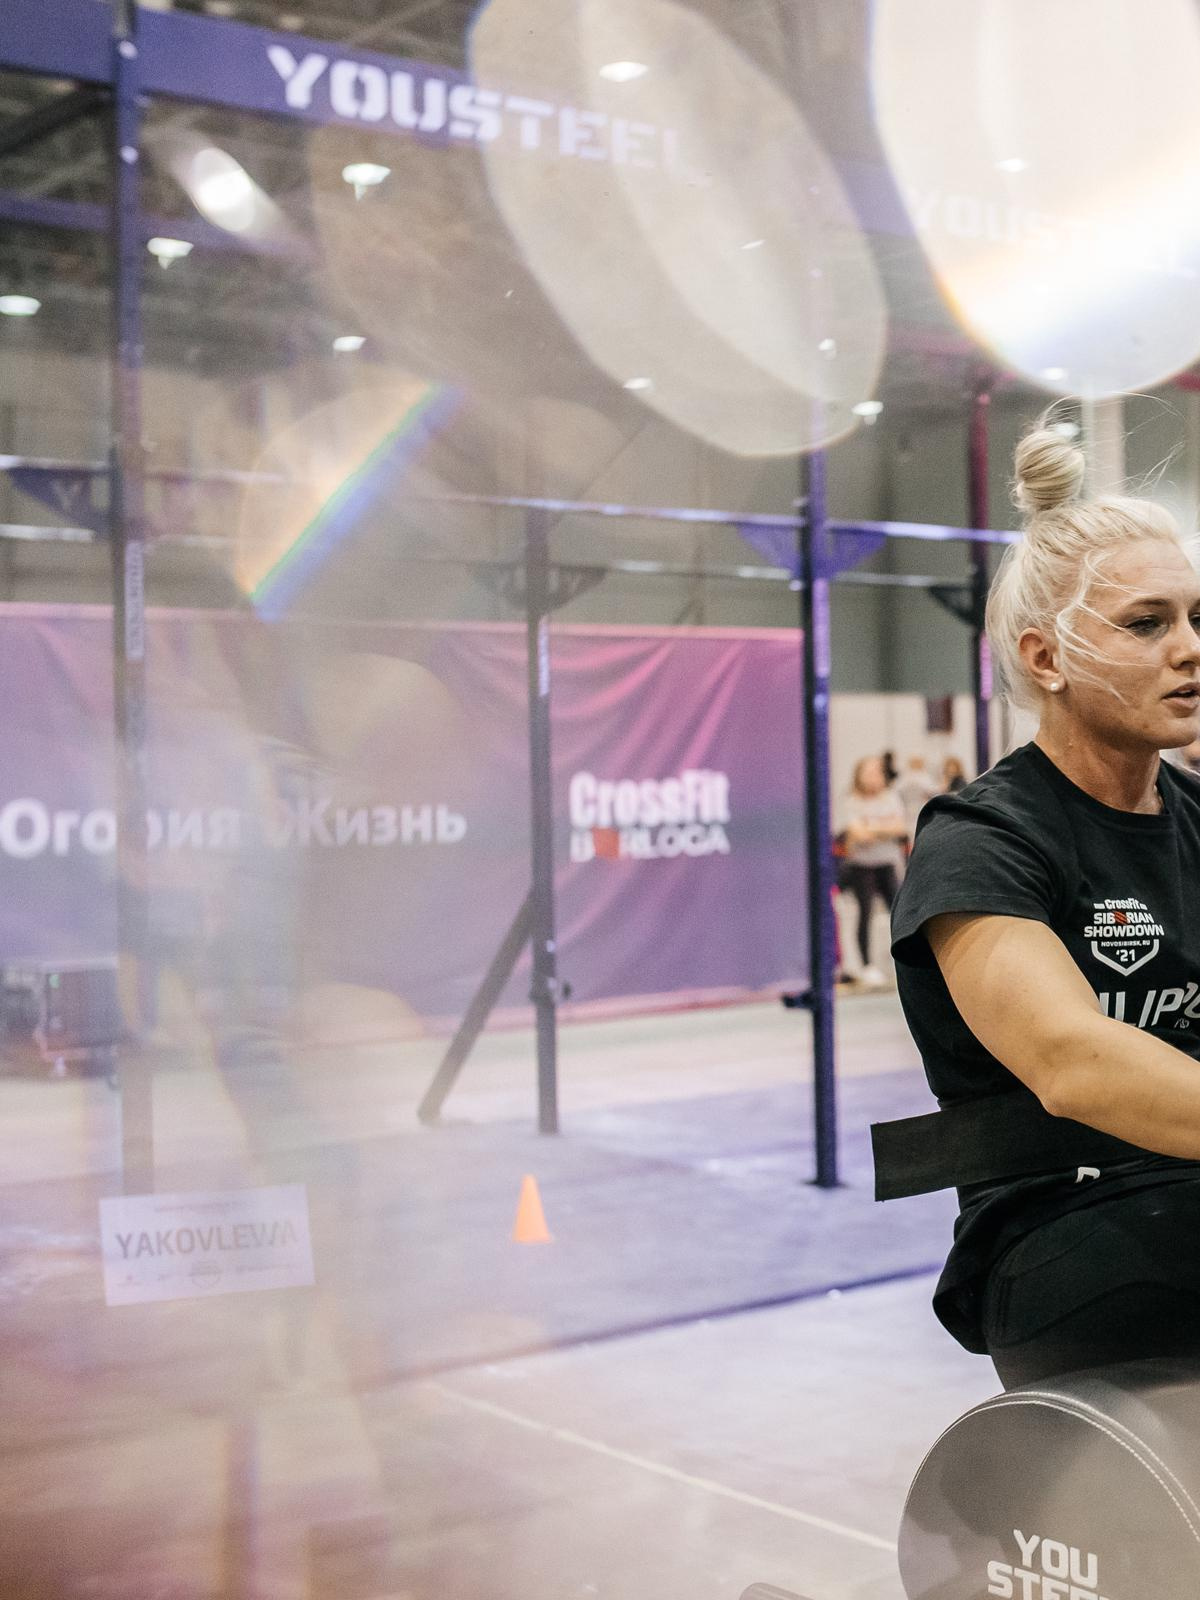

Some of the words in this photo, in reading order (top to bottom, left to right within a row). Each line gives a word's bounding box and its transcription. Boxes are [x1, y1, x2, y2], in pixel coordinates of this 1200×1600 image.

[570, 768, 732, 828] CrossFit
[1104, 897, 1141, 910] CrossFit
[1083, 924, 1165, 938] SHOWDOWN
[1013, 1528, 1098, 1589] YOU
[986, 1560, 1110, 1600] STE
